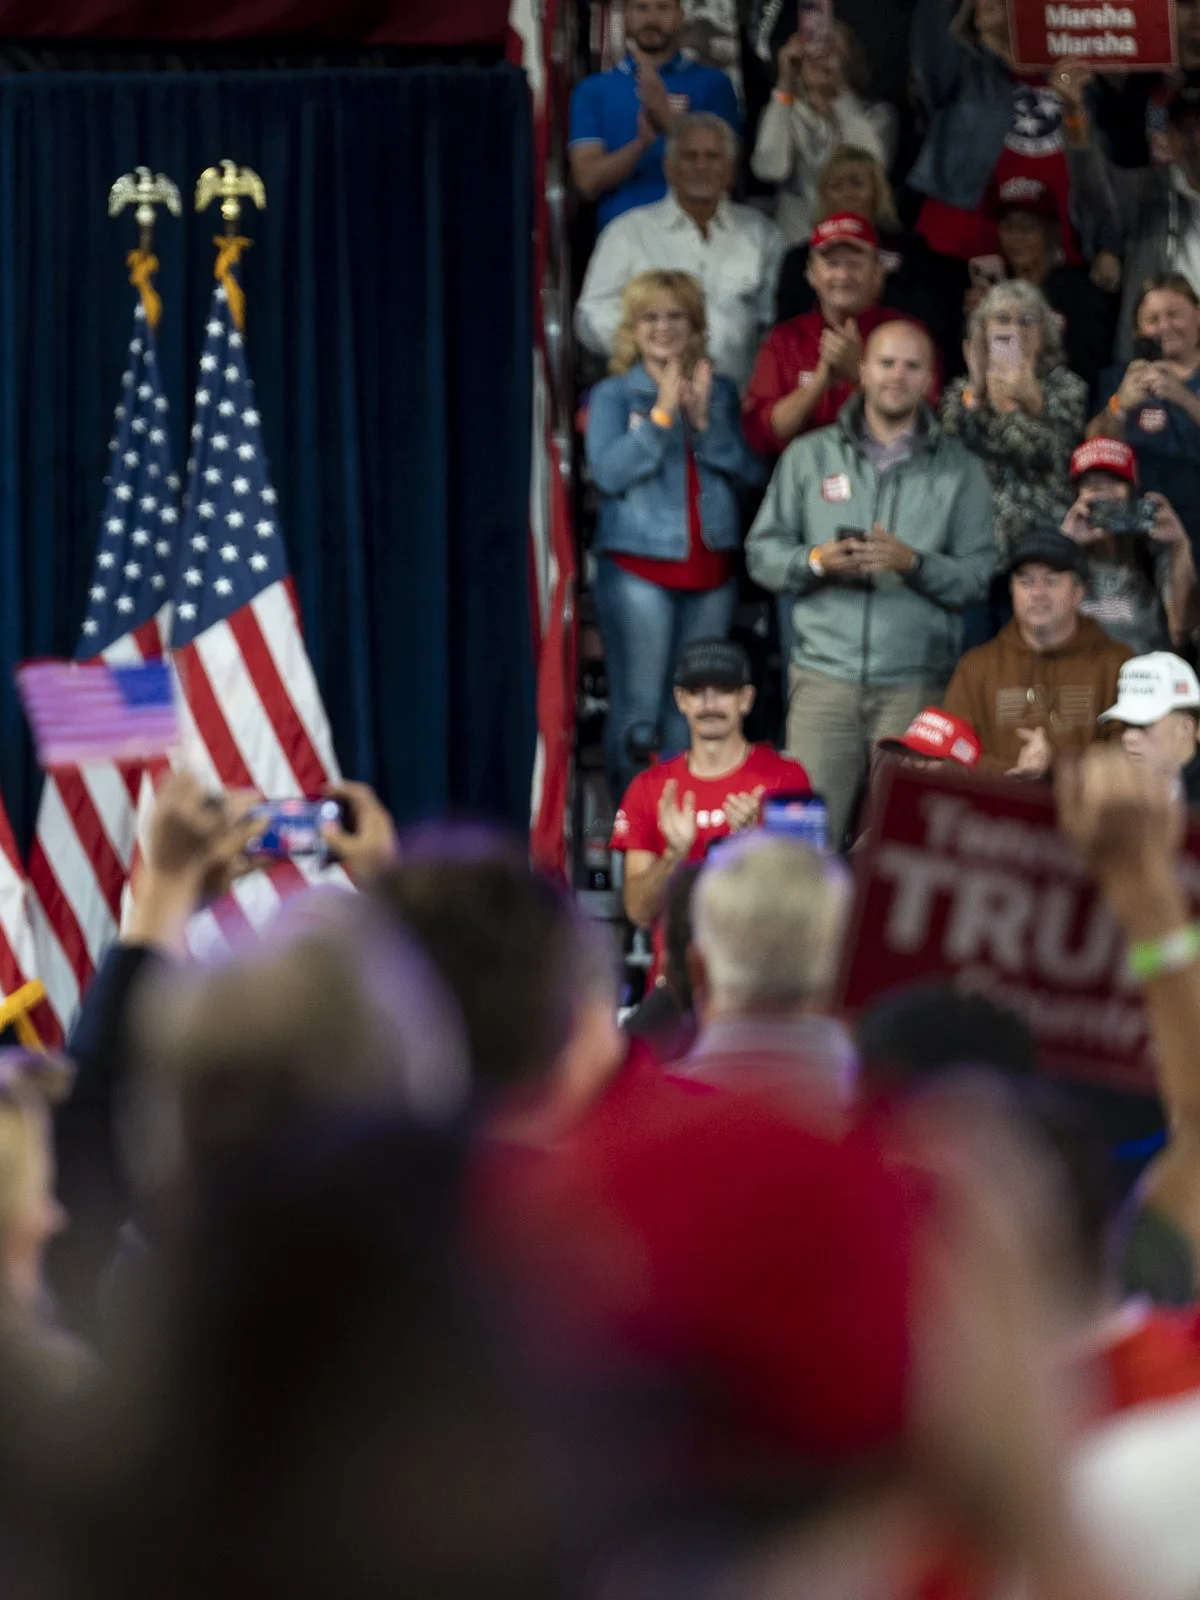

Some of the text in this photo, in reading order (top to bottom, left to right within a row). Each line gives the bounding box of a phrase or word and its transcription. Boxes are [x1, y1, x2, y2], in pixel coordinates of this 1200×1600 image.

[1045, 4, 1136, 28] Marsha
[1047, 32, 1137, 56] Marsha
[877, 842, 1138, 986] TRU
